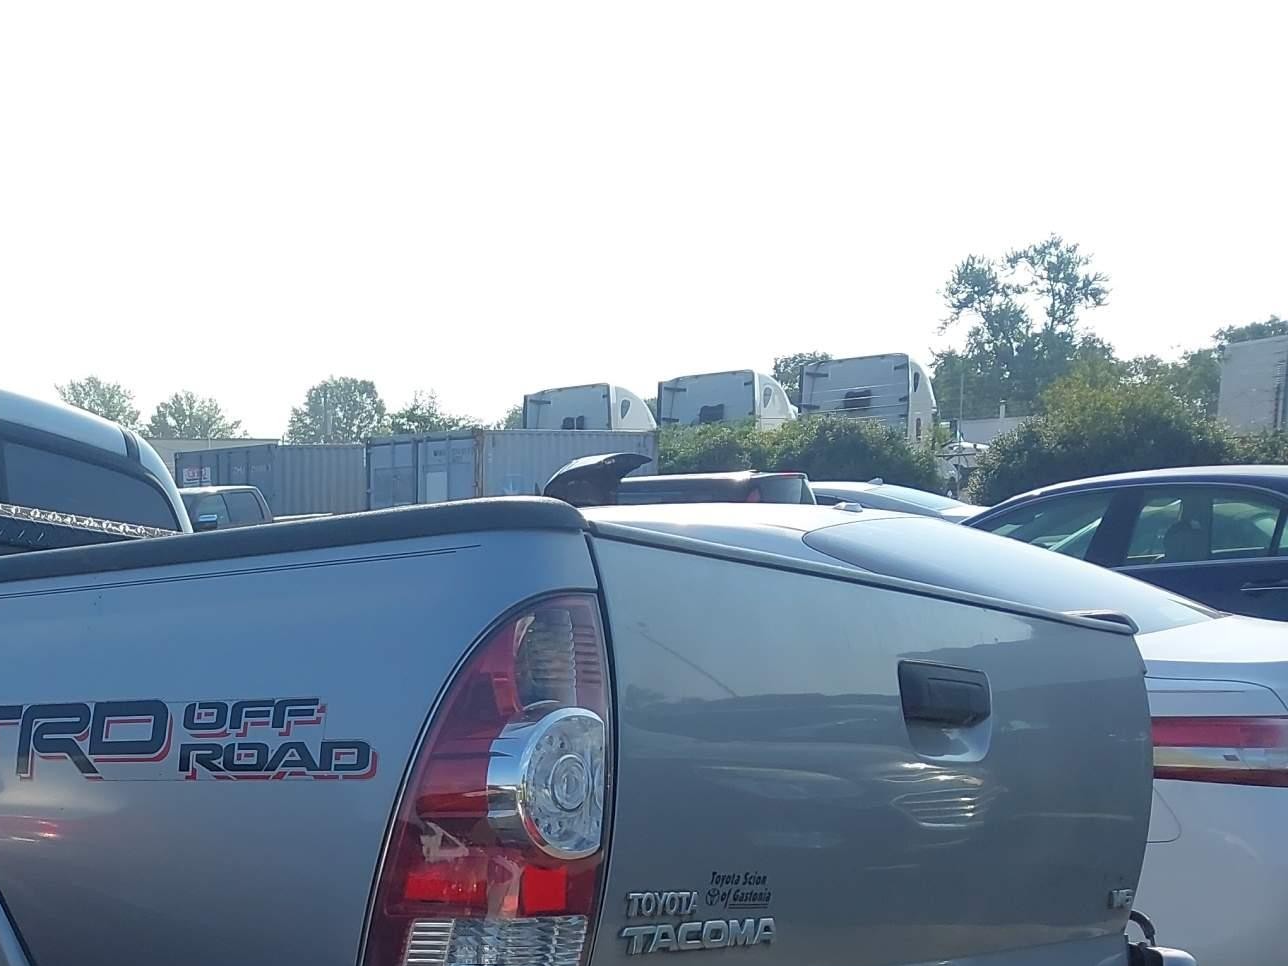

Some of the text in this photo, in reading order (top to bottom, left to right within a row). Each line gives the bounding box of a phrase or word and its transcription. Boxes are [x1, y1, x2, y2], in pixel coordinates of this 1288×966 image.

[182, 698, 327, 737] OFF
[178, 740, 377, 780] ROAD
[710, 870, 768, 888] Toyota Scion
[627, 890, 698, 917] TOYOTA
[720, 887, 772, 910] of Gastonia
[619, 917, 776, 955] TACOMA
